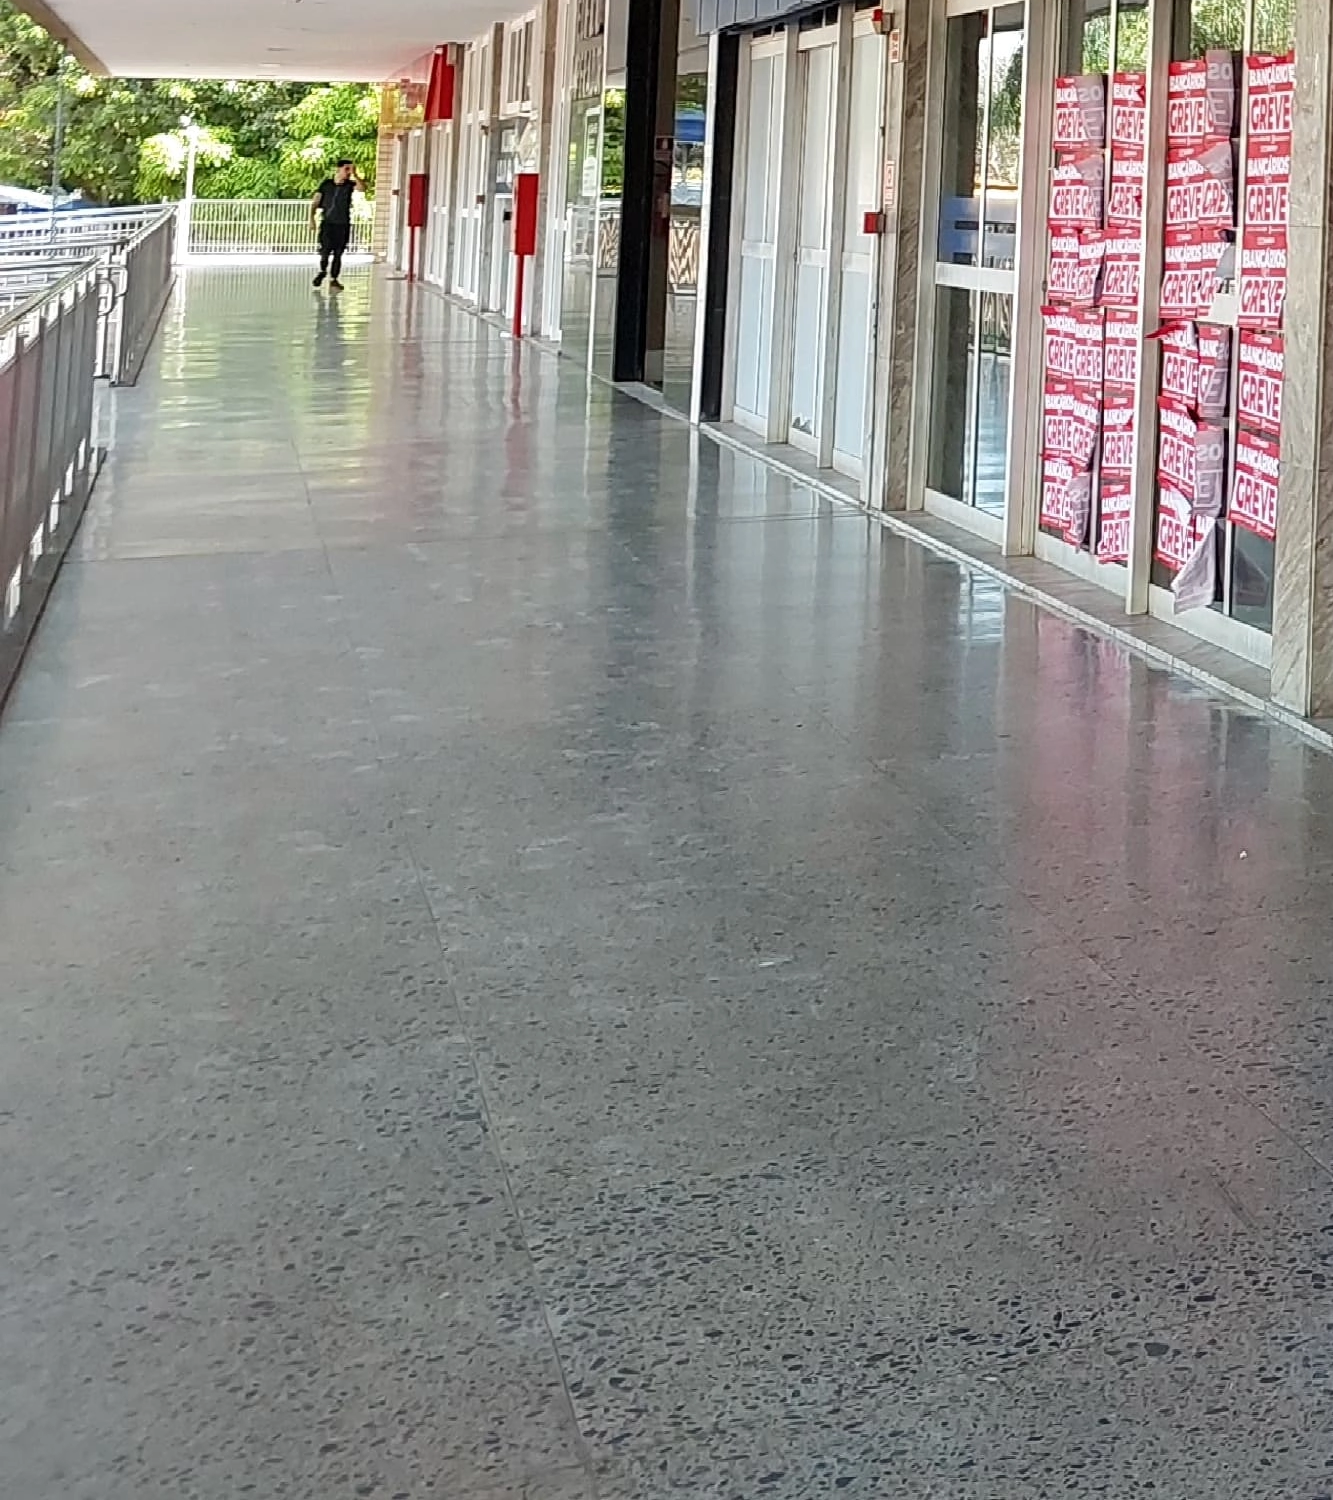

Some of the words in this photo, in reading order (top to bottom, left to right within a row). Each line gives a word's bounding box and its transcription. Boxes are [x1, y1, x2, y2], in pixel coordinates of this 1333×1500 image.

[1171, 100, 1204, 133] GREVE
[1251, 94, 1291, 131] GREVE
[1248, 186, 1286, 220] GREVE
[1241, 282, 1284, 316] GREVE
[1241, 373, 1281, 418] GREVE
[1236, 471, 1276, 525] GREVE
